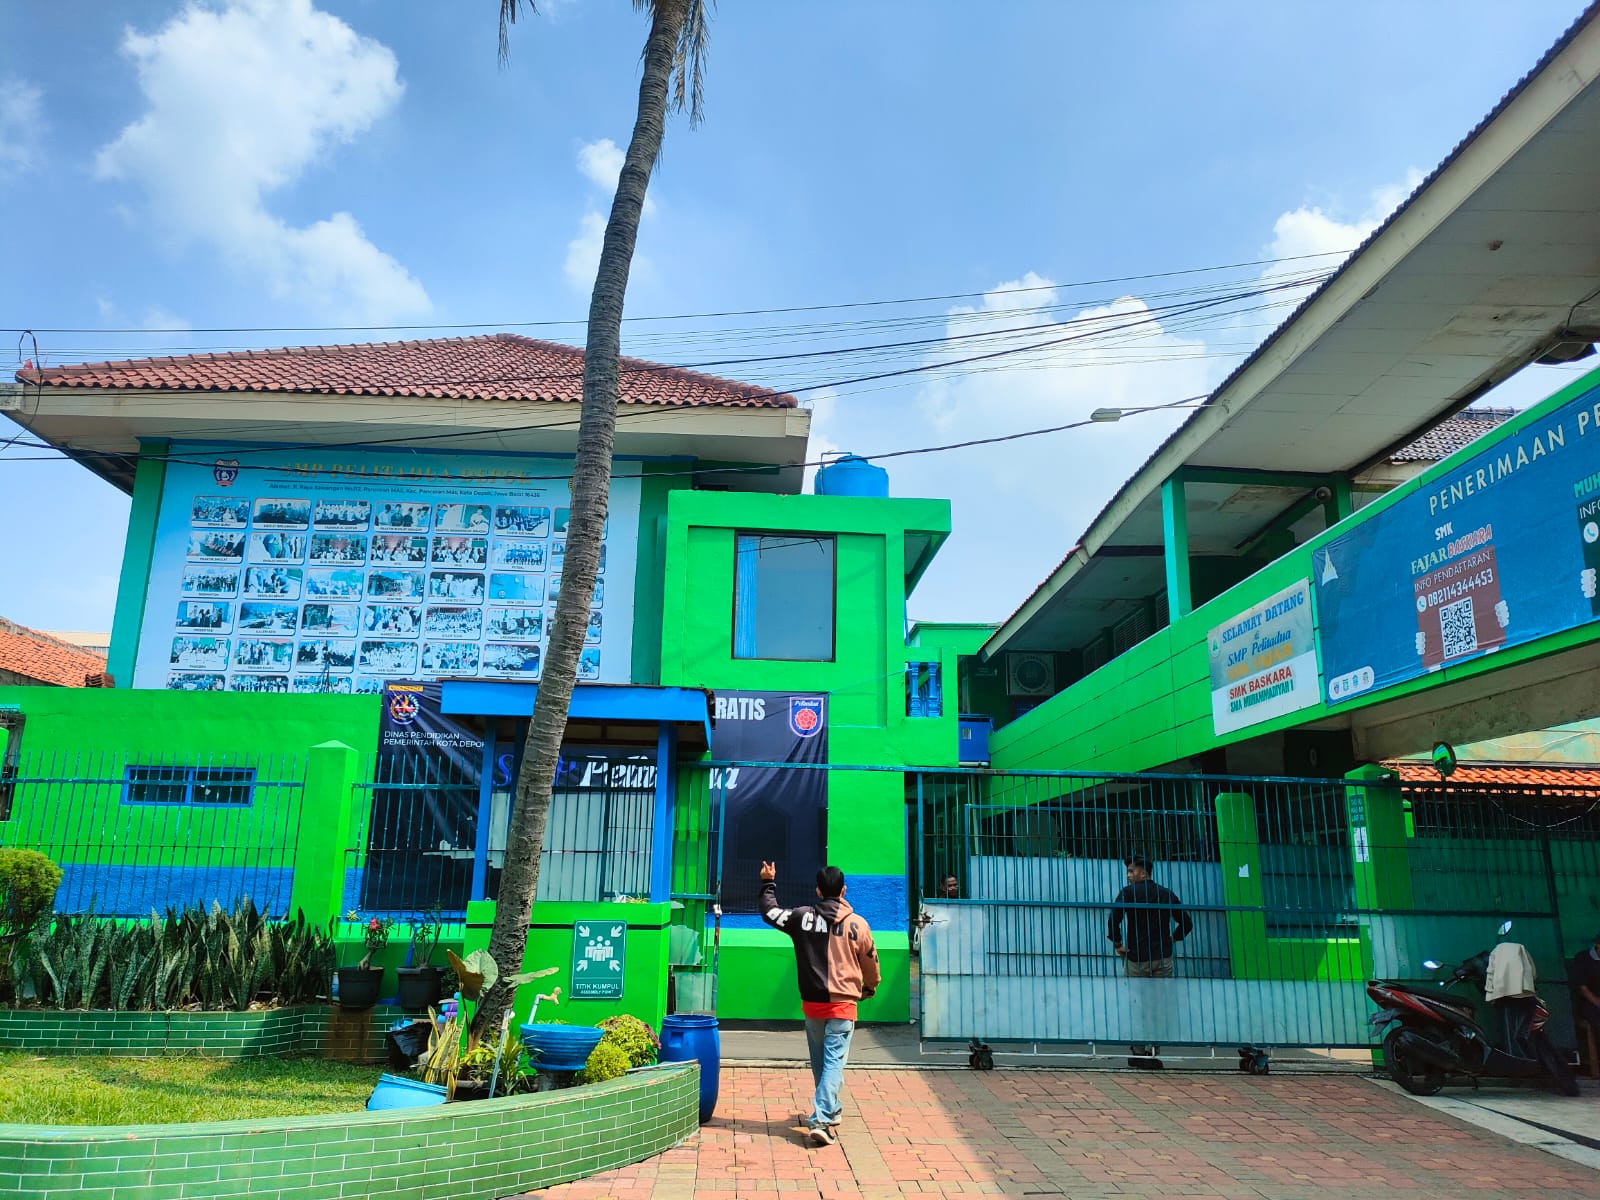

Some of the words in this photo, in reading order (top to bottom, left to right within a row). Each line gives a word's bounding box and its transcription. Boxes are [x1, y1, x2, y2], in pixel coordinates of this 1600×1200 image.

[281, 462, 323, 478] SMP
[460, 467, 533, 485] DEPOK
[1429, 424, 1565, 516] PENERIMAAN
[1435, 522, 1453, 540] SMK
[1410, 547, 1448, 574] FAJAR
[1448, 524, 1492, 558] BASKARA
[1415, 578, 1432, 592] INFO
[1428, 568, 1493, 607] 082114344453
[1222, 612, 1263, 644] SELAMAT
[1265, 591, 1304, 622] DATANG
[1227, 648, 1248, 667] SMP
[1251, 629, 1292, 655] Pelitadua
[1229, 684, 1247, 700] SMK
[1249, 666, 1293, 692] BASKARA
[713, 697, 766, 720] RATIS
[1230, 699, 1243, 713] SMA
[383, 738, 435, 747] PEMERINTAH
[436, 739, 458, 748] KOTA
[384, 730, 409, 738] DINAS
[410, 731, 460, 740] PENDIDIKAN
[493, 754, 577, 786] SP
